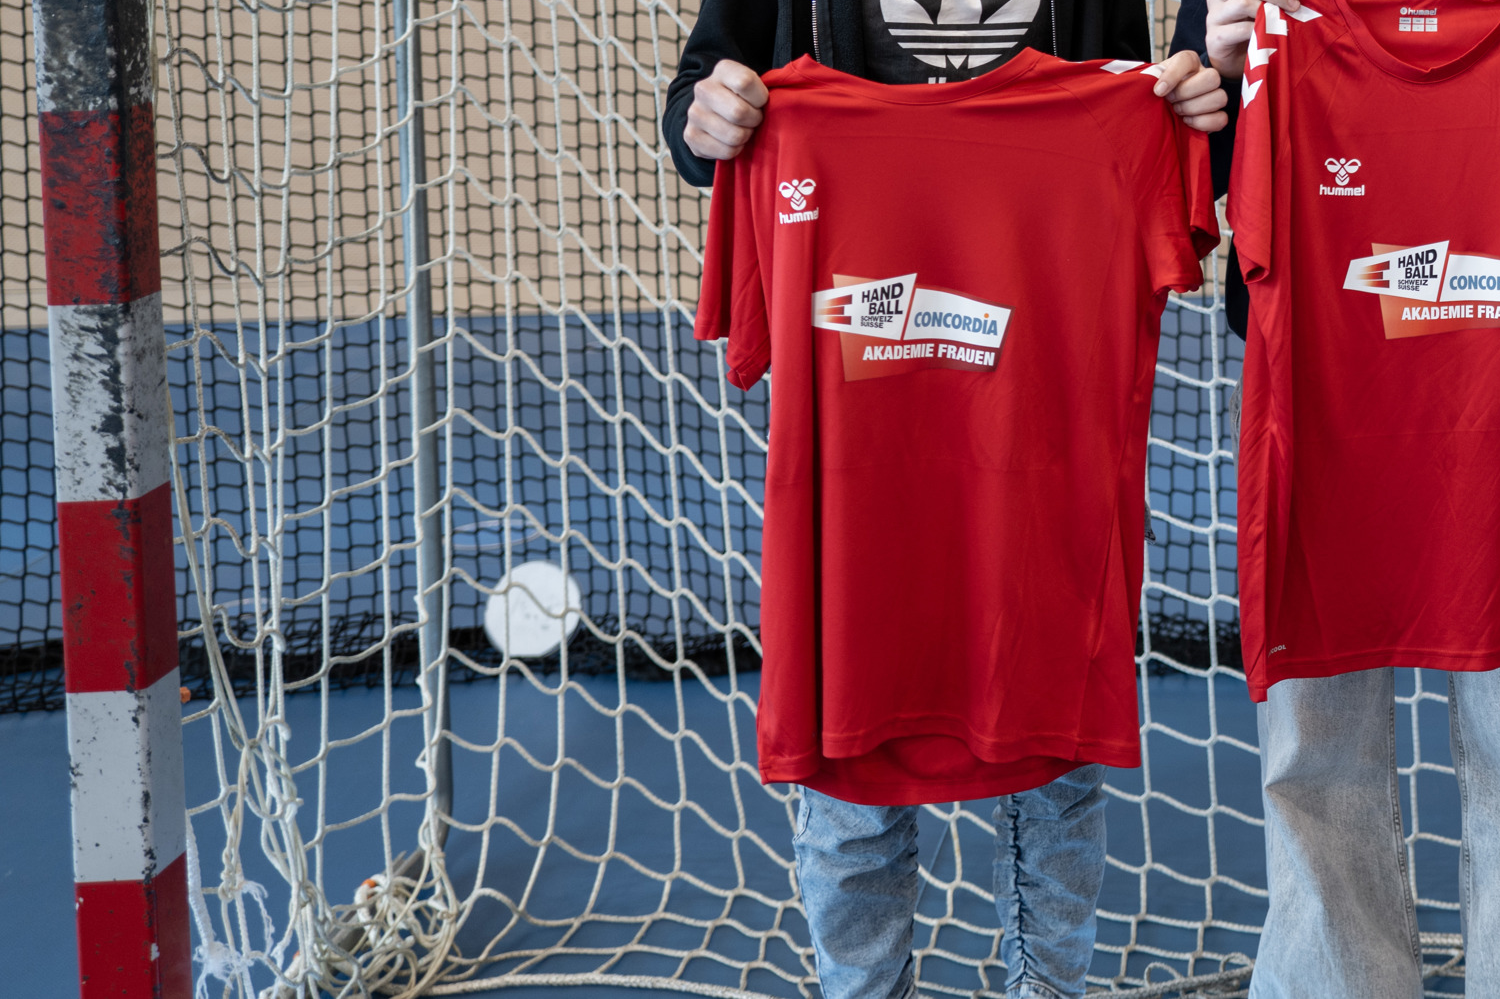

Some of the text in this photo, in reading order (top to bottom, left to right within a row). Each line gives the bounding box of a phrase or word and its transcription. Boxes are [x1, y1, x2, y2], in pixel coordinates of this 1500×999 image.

[1319, 184, 1365, 196] hummel
[1398, 248, 1438, 268] HAND
[1404, 264, 1438, 279] BALL
[862, 282, 904, 304] HAND
[868, 299, 904, 315] BALL
[1401, 304, 1474, 321] AKADEMIE
[860, 315, 893, 323] SCHWEIZ
[860, 321, 884, 329] SUISSE
[862, 343, 996, 366] AKADEMIE FRAUEN
